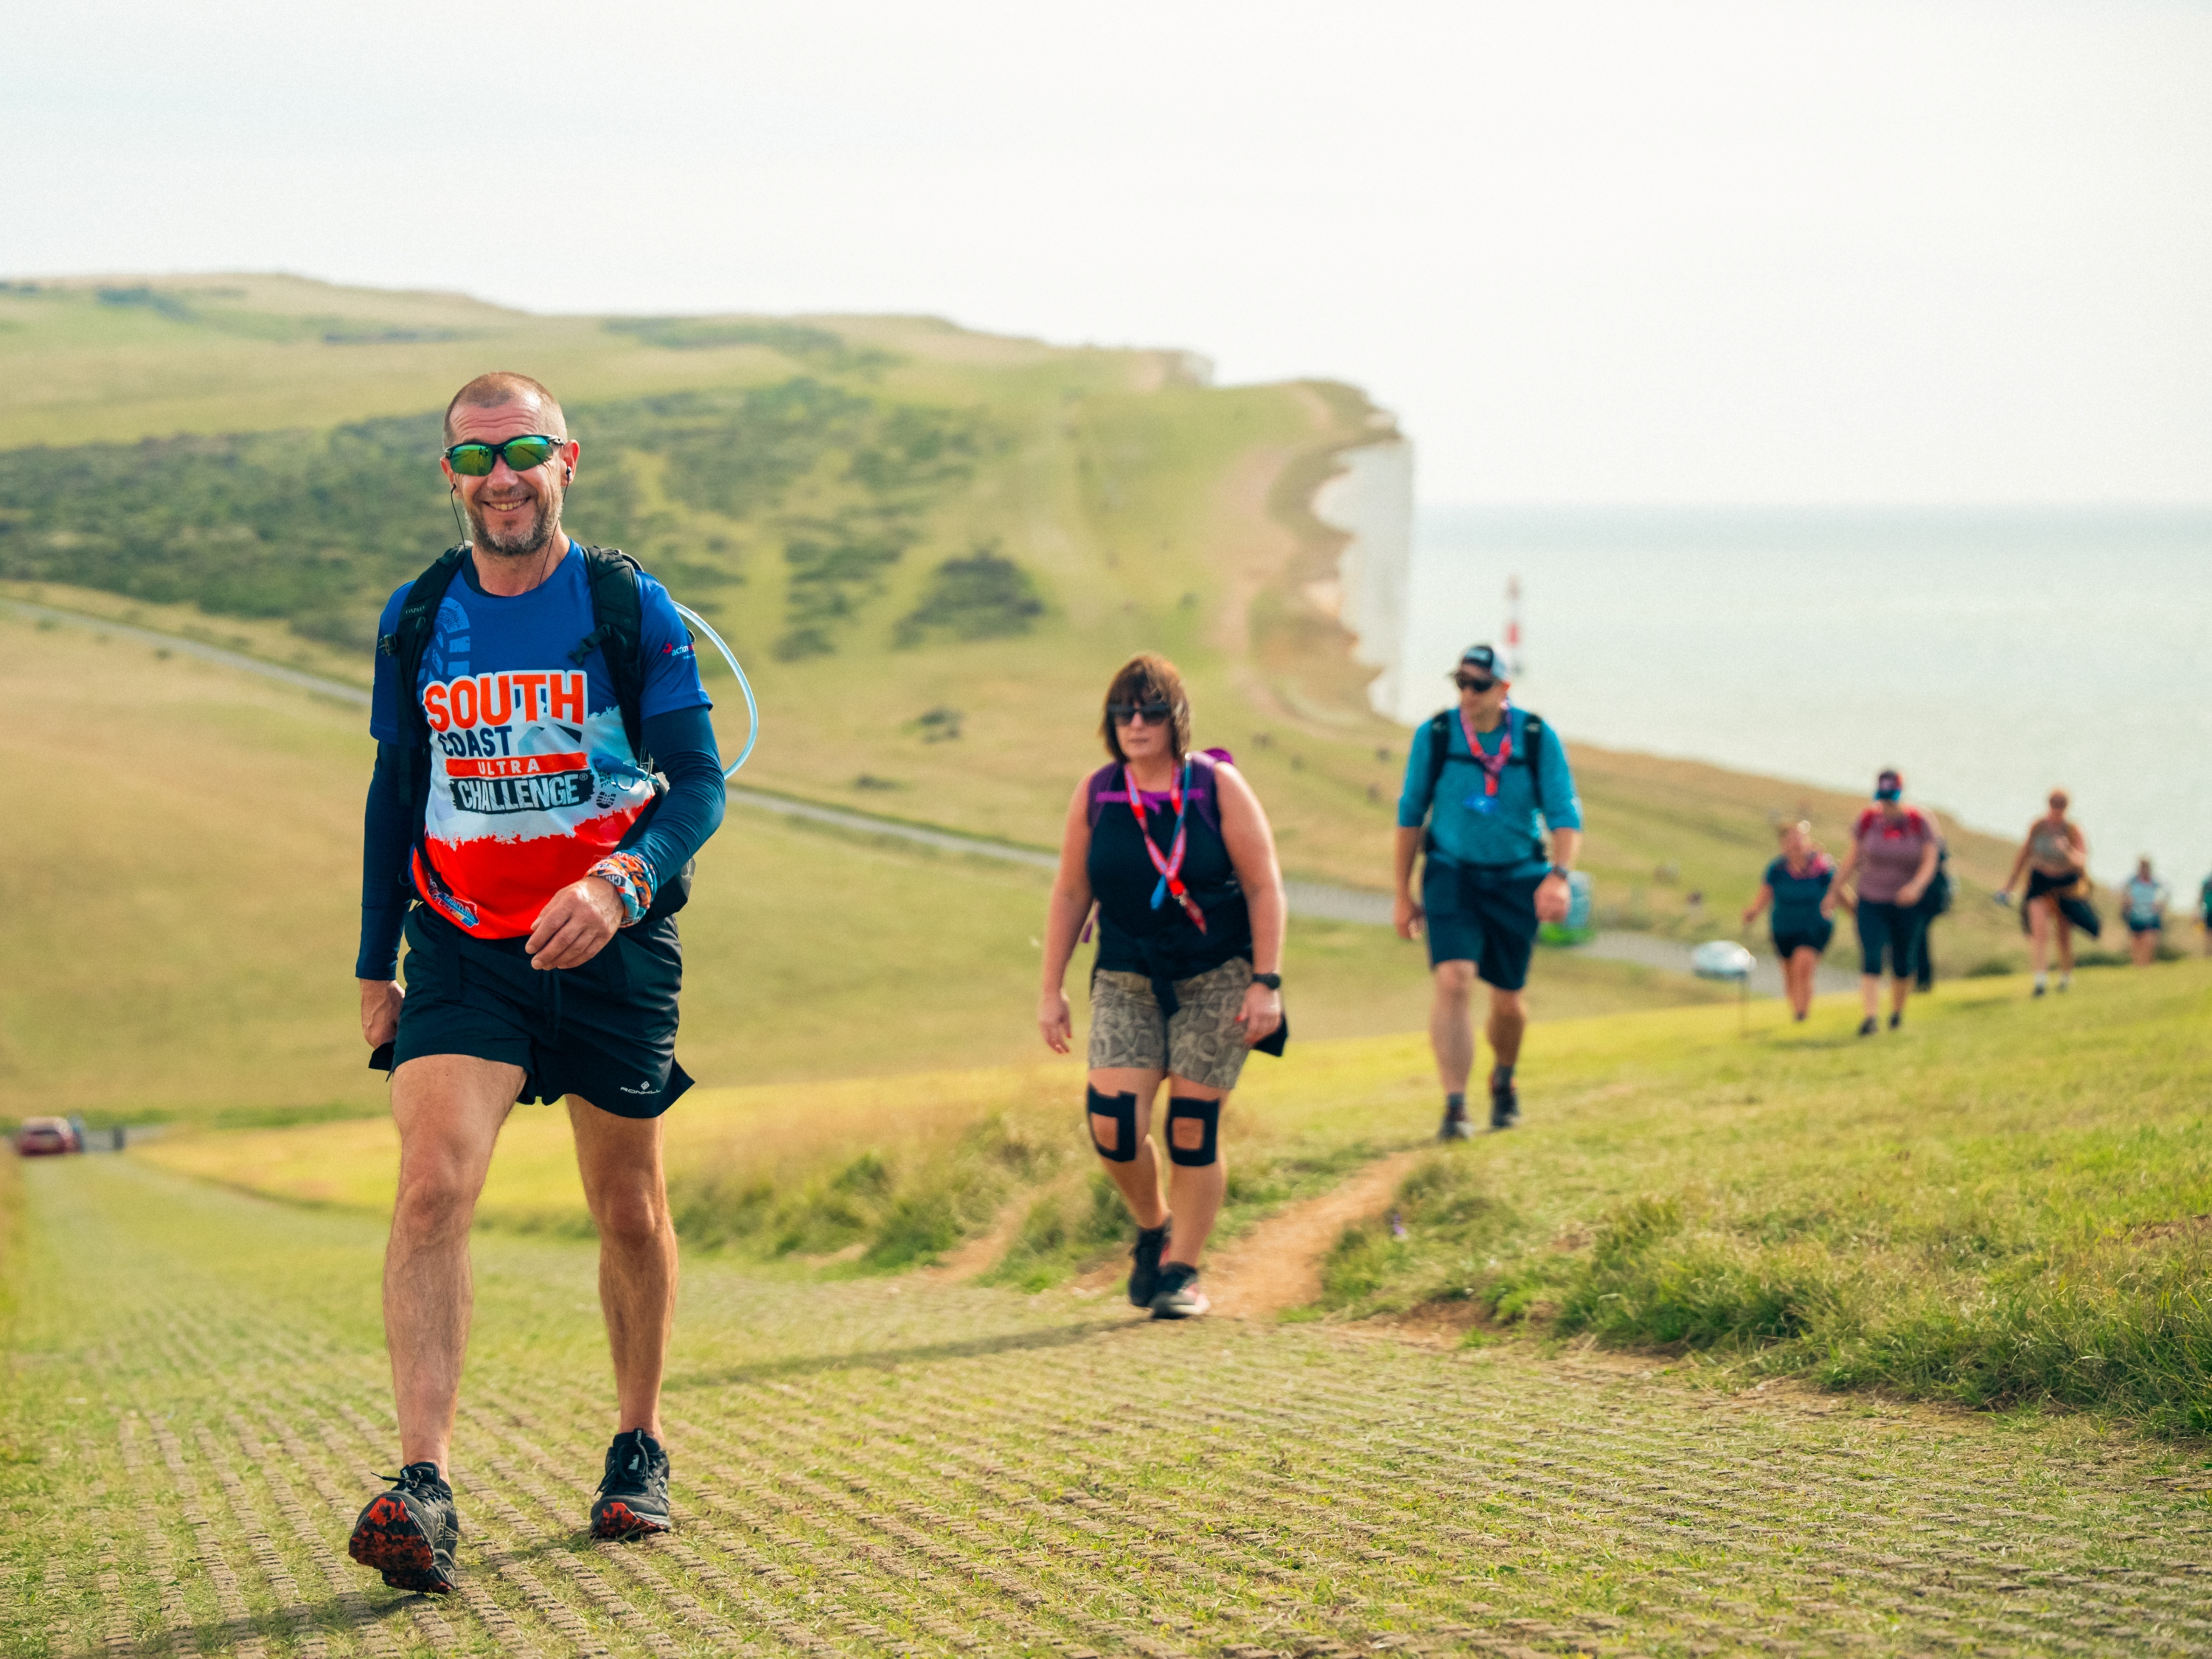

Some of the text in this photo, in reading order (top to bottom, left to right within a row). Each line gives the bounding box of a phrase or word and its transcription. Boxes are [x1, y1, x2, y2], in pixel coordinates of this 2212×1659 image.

[423, 673, 584, 733] SOUTH
[438, 726, 512, 758] COAST
[478, 758, 540, 775] ULTRA
[457, 773, 580, 812] CHALLENGE
[620, 1086, 661, 1095] RONHILL
